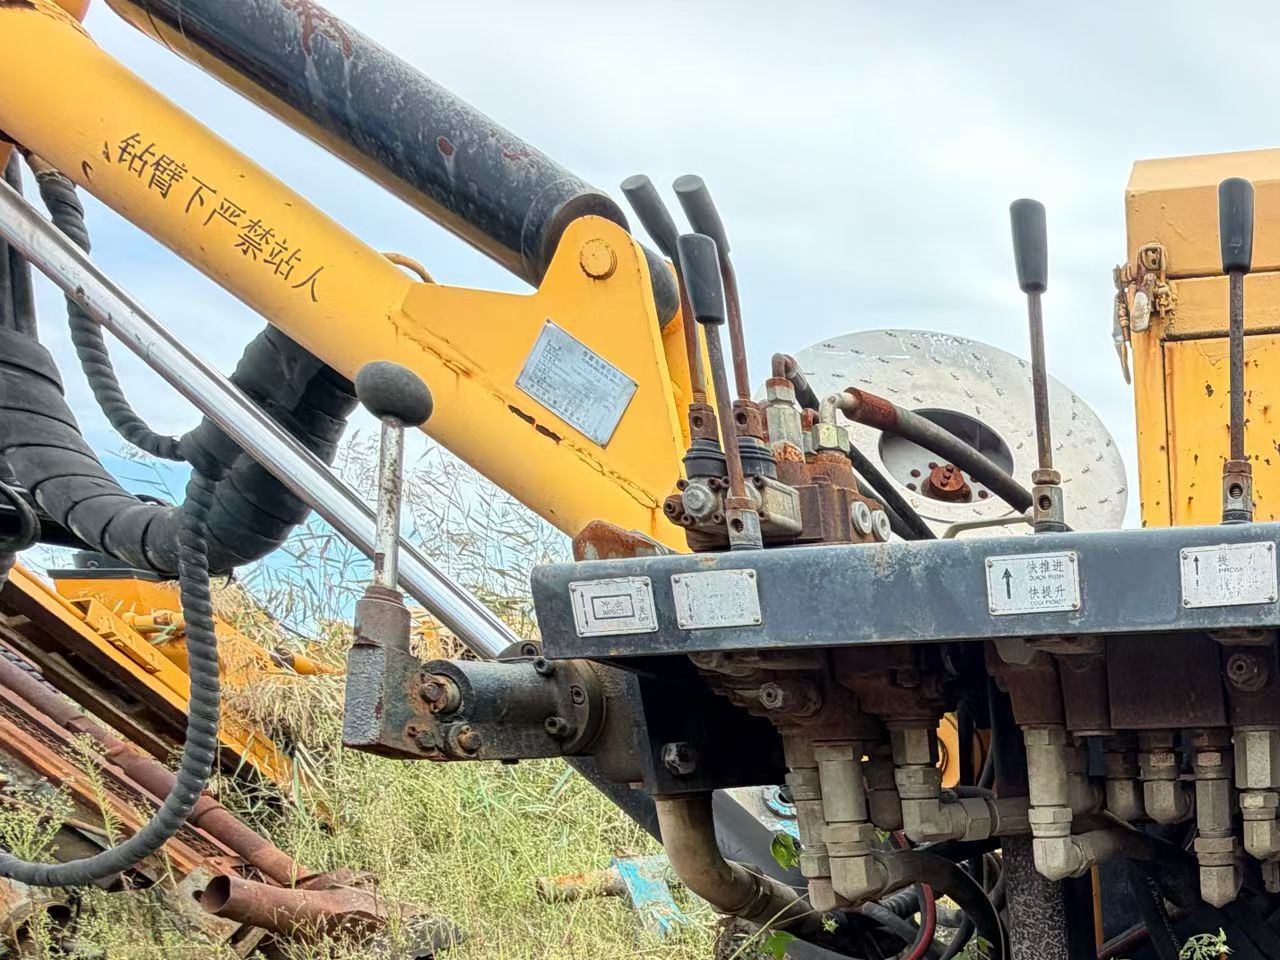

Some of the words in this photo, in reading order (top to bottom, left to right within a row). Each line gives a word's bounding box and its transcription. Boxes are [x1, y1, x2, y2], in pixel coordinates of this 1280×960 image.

[117, 132, 325, 303] 钻臂下严禁站人
[1027, 558, 1064, 574] 快推进
[1028, 584, 1066, 600] 快提升
